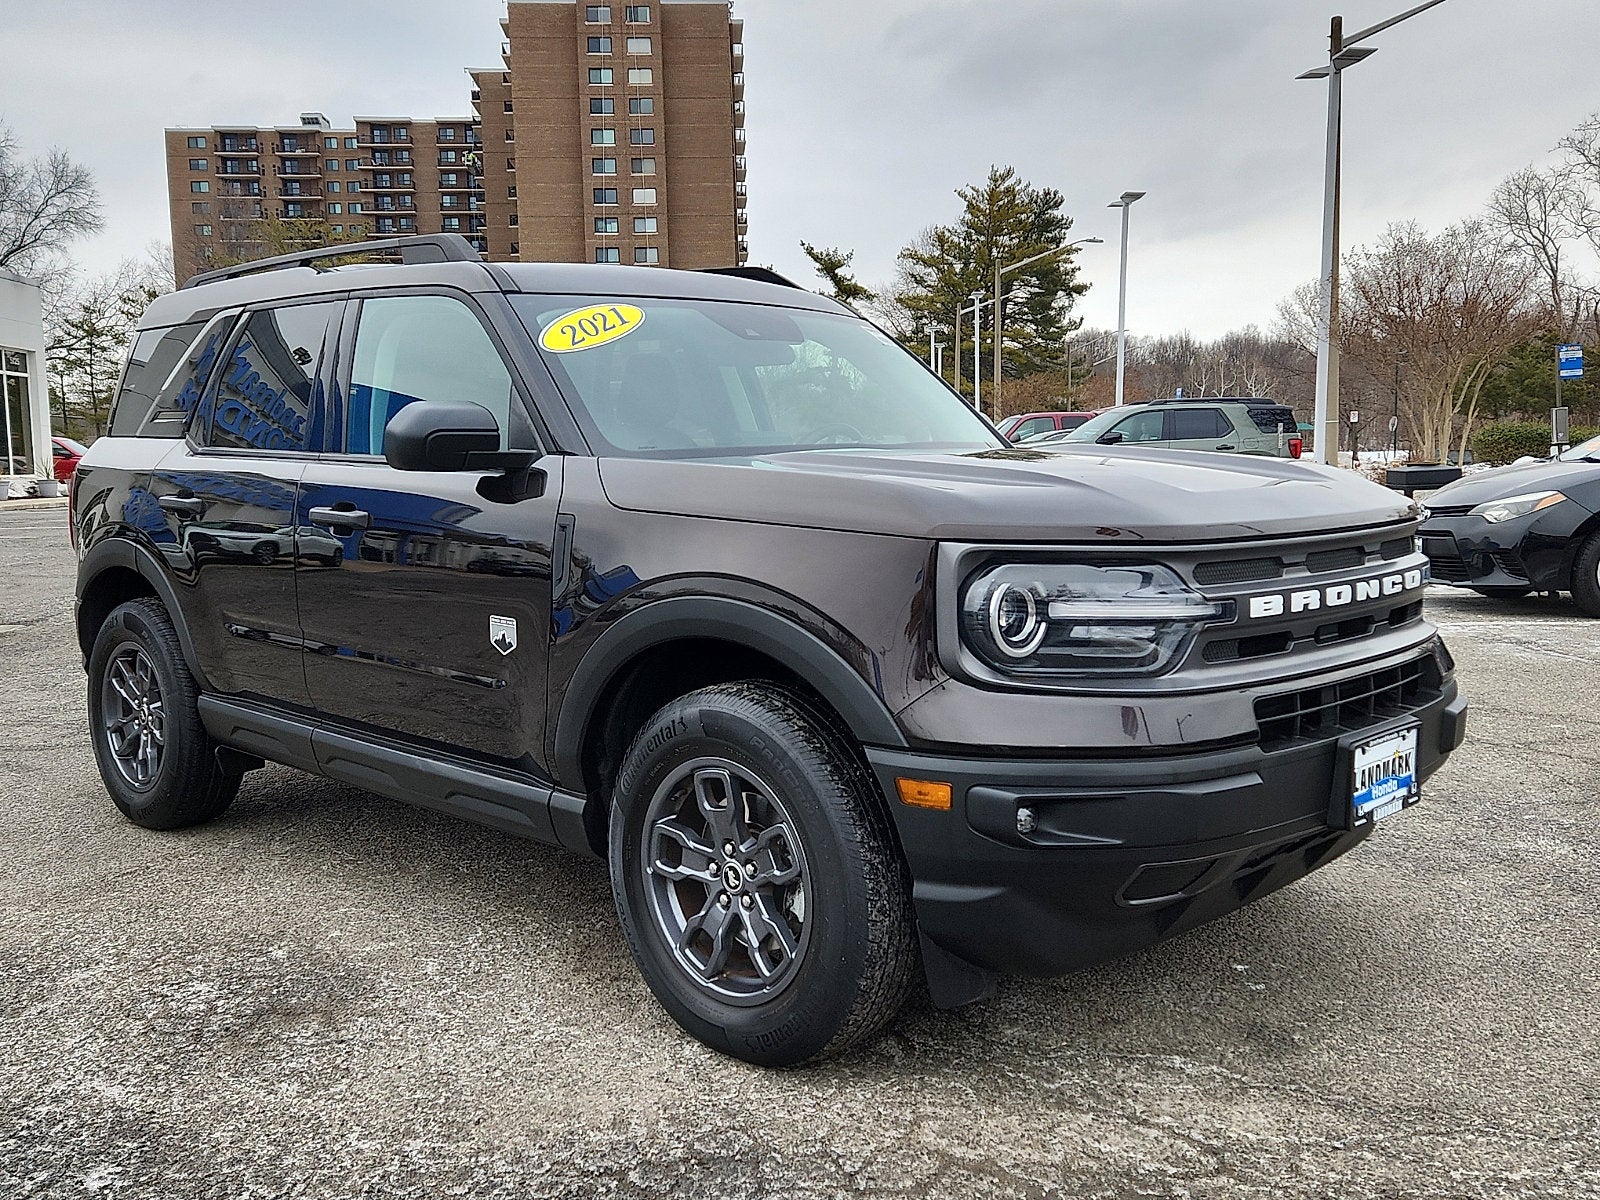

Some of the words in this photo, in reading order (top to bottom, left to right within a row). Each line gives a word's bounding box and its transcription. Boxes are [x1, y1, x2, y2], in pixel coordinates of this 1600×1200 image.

[560, 307, 630, 346] 2021
[1249, 570, 1421, 618] BRONCO
[1354, 750, 1412, 792] LANDMARK
[1371, 779, 1398, 799] Honda
